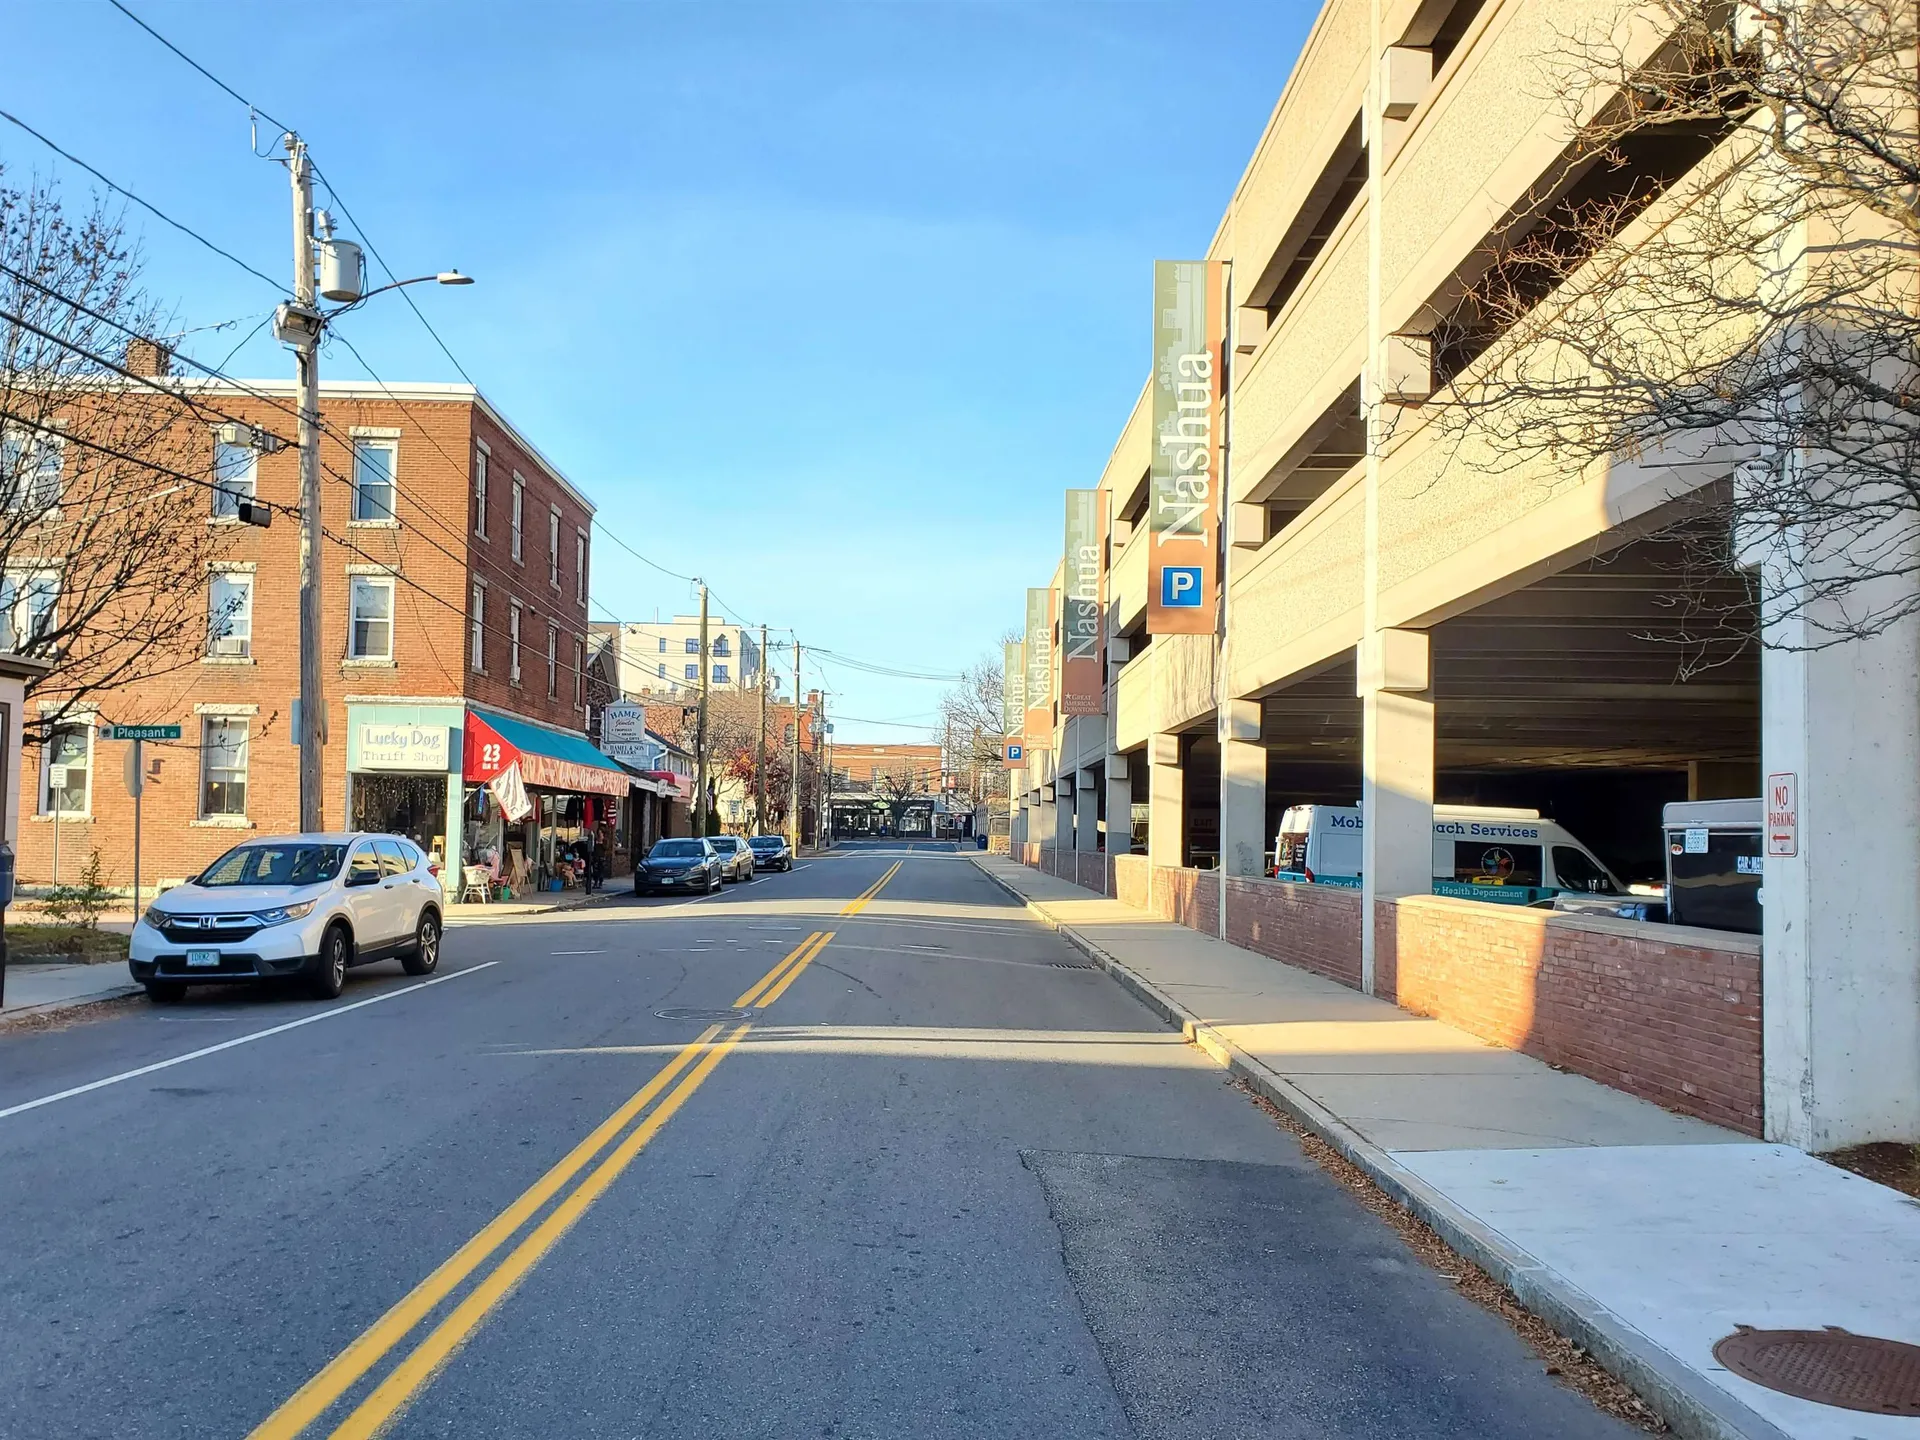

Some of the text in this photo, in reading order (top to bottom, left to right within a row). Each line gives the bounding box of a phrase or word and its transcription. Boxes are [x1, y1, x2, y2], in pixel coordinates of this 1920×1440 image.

[1157, 349, 1214, 548] Nashua
[1172, 571, 1194, 600] P
[1067, 544, 1100, 663] Nashua
[1028, 626, 1052, 712] Nashua
[1006, 674, 1025, 739] Nashua
[1071, 693, 1092, 701] GREAT
[610, 710, 641, 721] HAMEL
[117, 727, 166, 738] Pleasant
[365, 728, 441, 750] Lucky Dog
[362, 750, 444, 765] Thrift Shop
[482, 743, 501, 762] 23
[1010, 748, 1020, 758] P
[1775, 786, 1788, 806] NO
[1331, 815, 1363, 828] Mob
[1470, 823, 1538, 838] Services
[1769, 811, 1795, 827] PARKING
[1441, 886, 1471, 896] Health
[1472, 888, 1523, 898] Department
